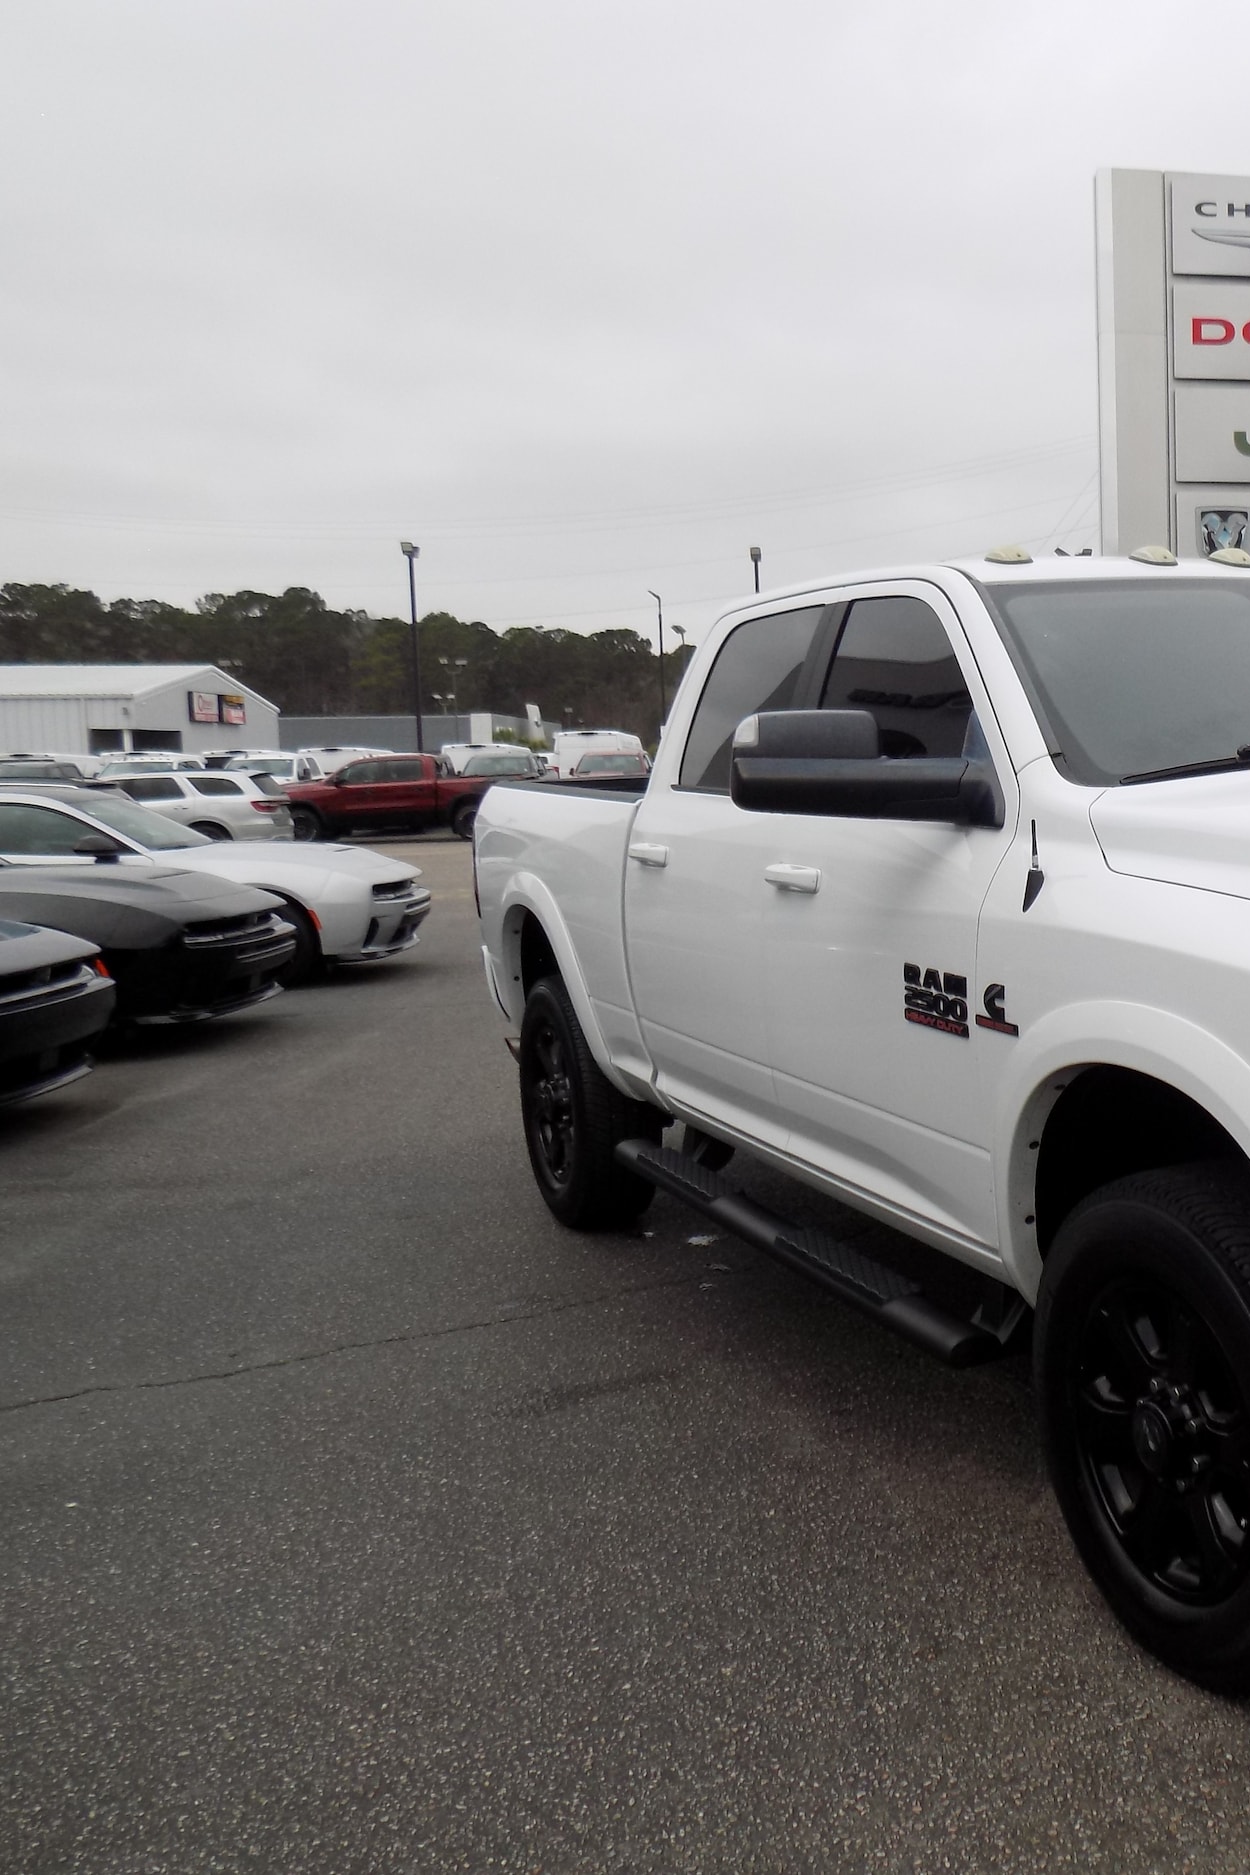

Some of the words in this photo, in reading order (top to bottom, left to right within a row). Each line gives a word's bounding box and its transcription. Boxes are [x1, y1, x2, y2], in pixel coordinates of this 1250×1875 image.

[904, 962, 967, 998] RAM
[904, 985, 968, 1022] 2500
[936, 1020, 964, 1035] DUTY
